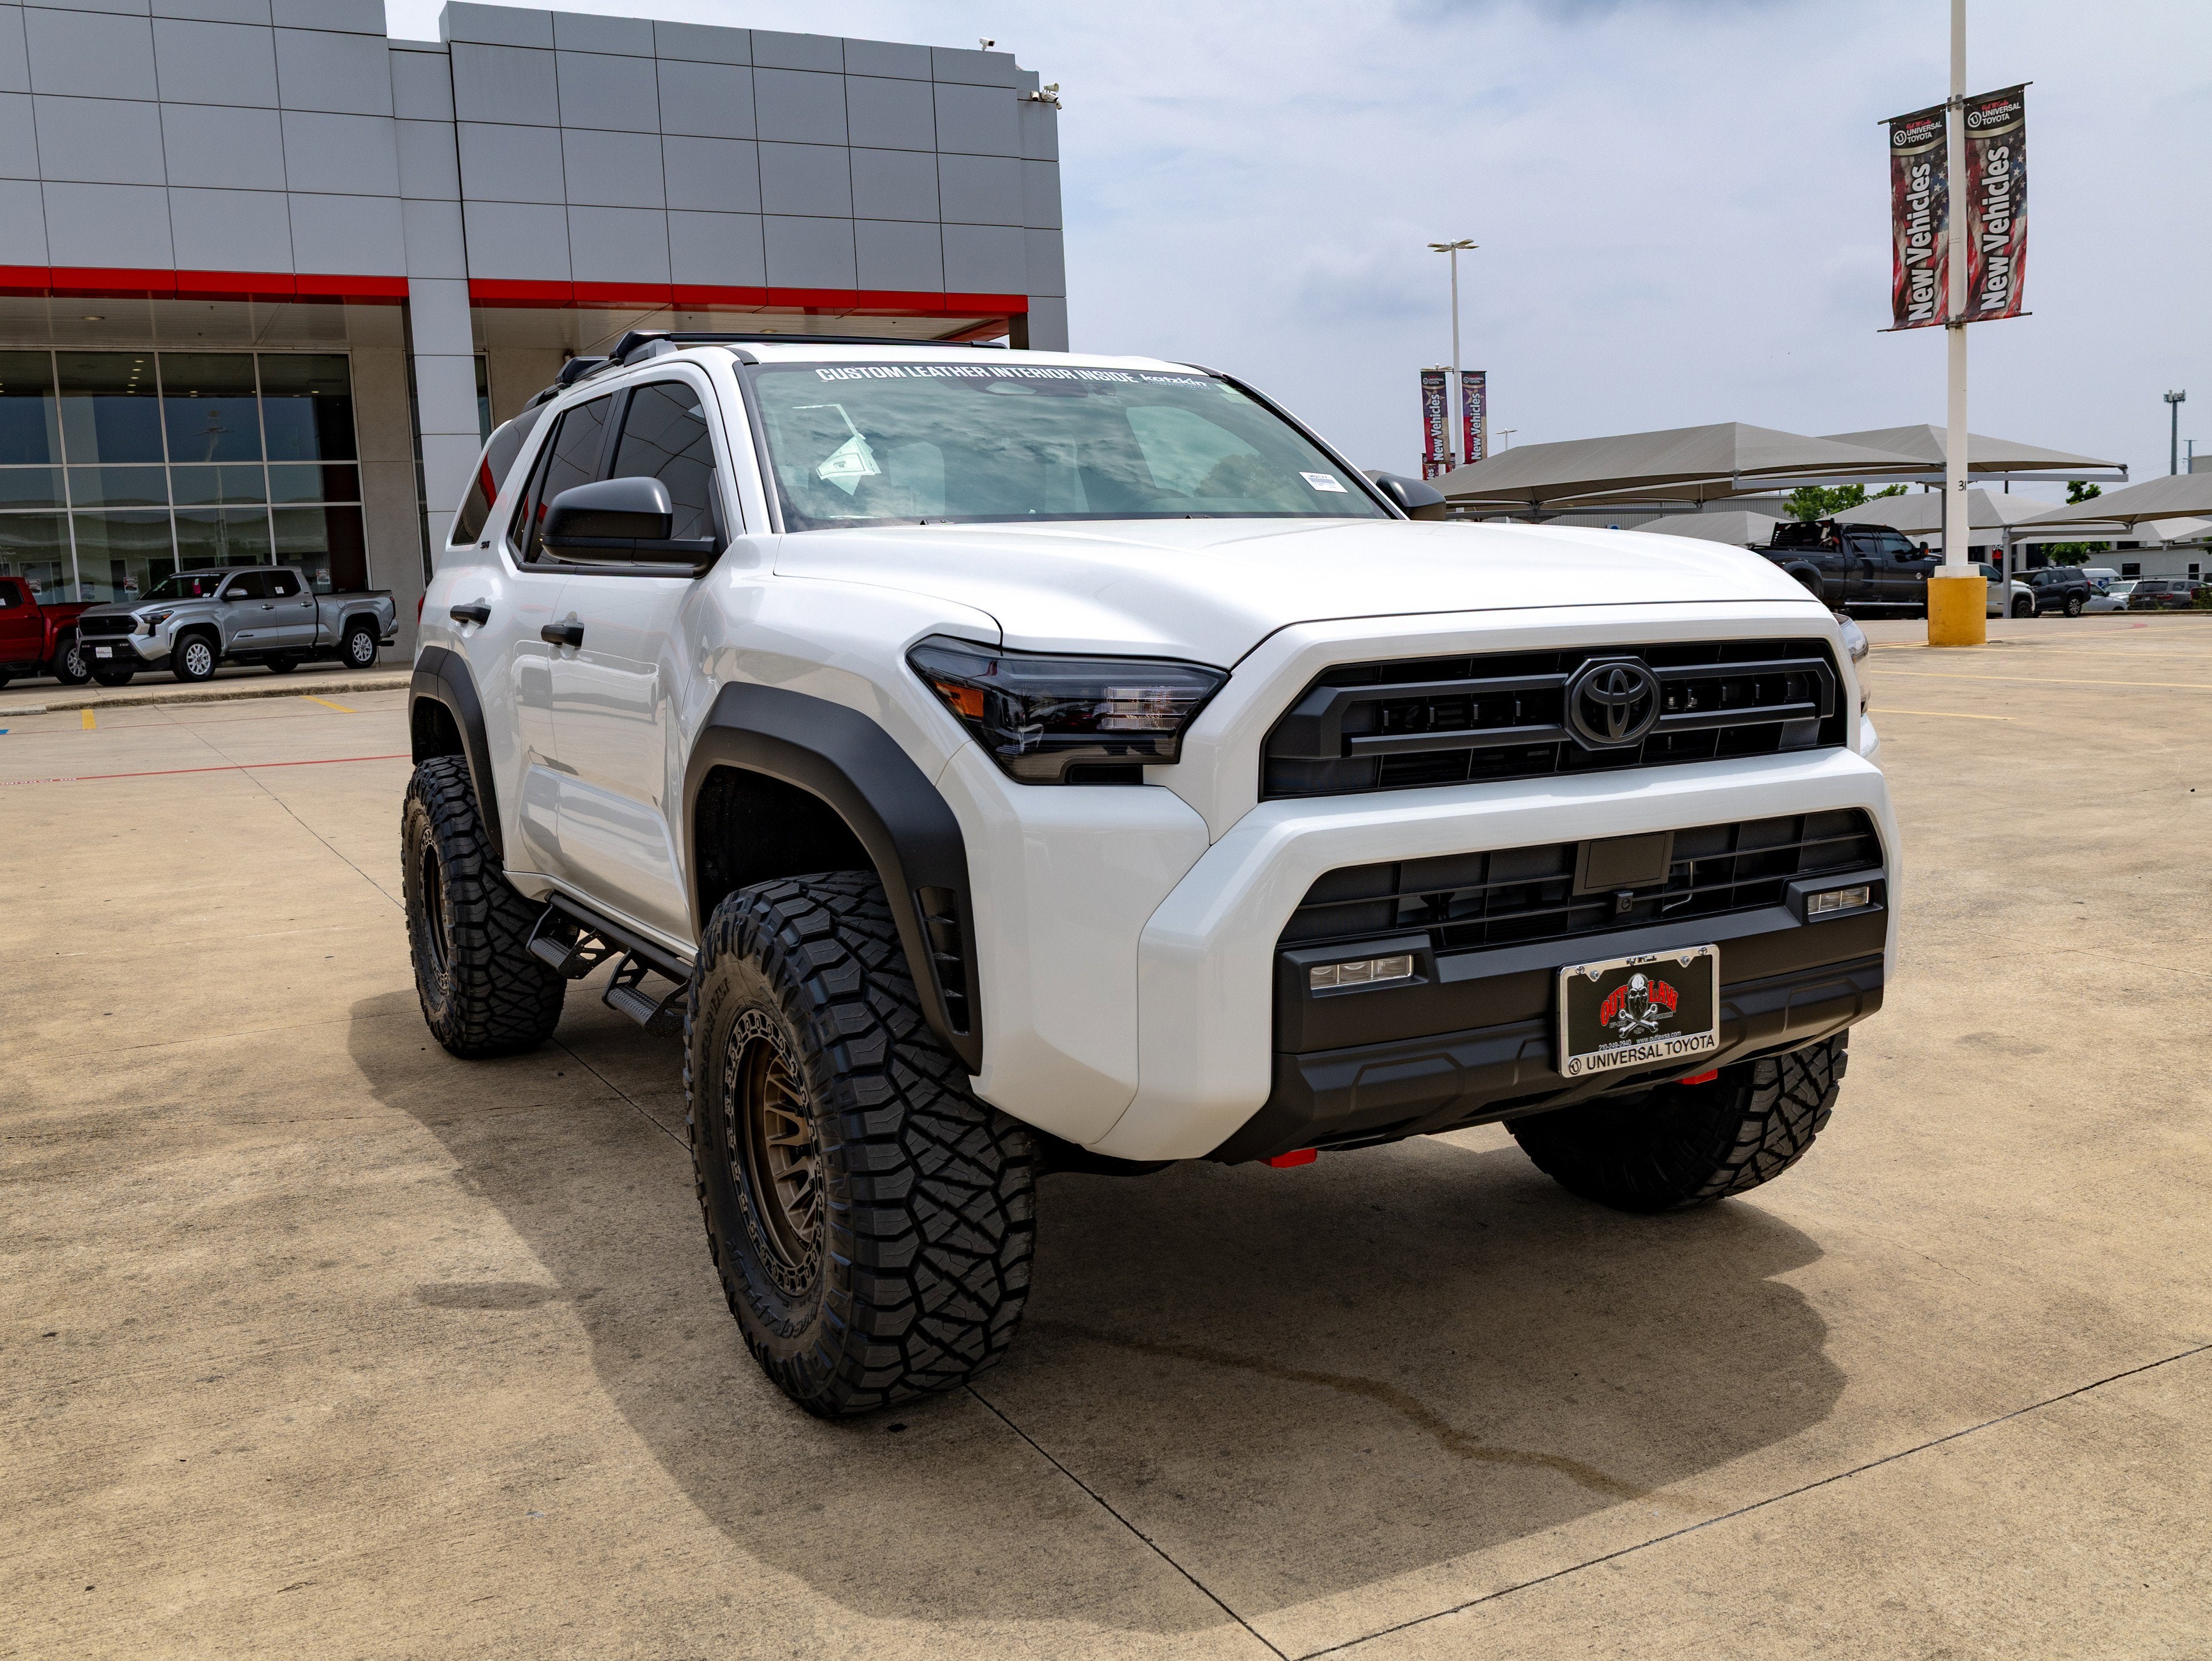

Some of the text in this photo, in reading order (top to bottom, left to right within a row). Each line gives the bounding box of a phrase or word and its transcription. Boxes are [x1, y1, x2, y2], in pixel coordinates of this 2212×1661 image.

[1982, 102, 2021, 118] UNIVERSAL
[1982, 113, 2010, 125] TOYOTA
[1907, 121, 1943, 136] UNIVERSAL
[1907, 131, 1933, 143] TOYOTA
[1980, 145, 2010, 312] New Vehicles
[1906, 162, 1934, 322] New Vehicles
[815, 366, 908, 381] CUSTOM
[903, 366, 993, 378] LEATHER
[986, 366, 1079, 380] INTERIOR
[1073, 369, 1139, 383] INSIDE
[1429, 394, 1444, 461] New Vehicles
[1470, 392, 1481, 460] New Vehicles
[1958, 480, 1967, 491] 31
[1598, 1039, 1632, 1051] 210-249-2940
[1636, 1031, 1681, 1044] www.outlawsa.com
[1586, 1034, 1715, 1070] UNIVERSAL TOYOTA
